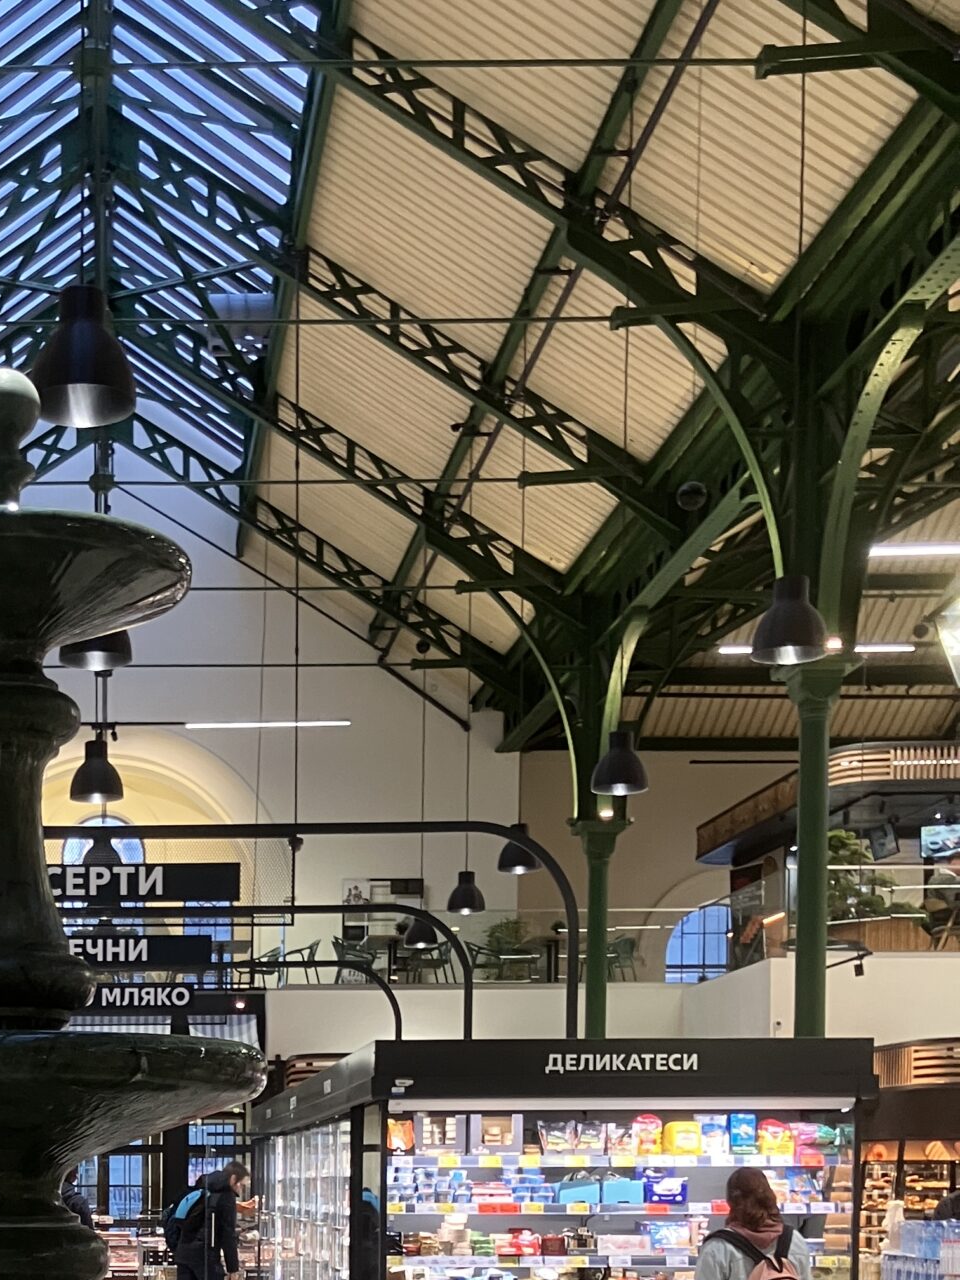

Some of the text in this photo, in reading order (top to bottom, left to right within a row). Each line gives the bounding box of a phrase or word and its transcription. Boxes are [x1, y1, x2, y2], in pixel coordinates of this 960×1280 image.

[47, 866, 163, 896] СЕРТИ
[69, 938, 149, 962] ЕЧНИ
[101, 986, 191, 1006] МЛЯКО
[545, 1053, 698, 1074] ДЕЛИКАТЕСИ
